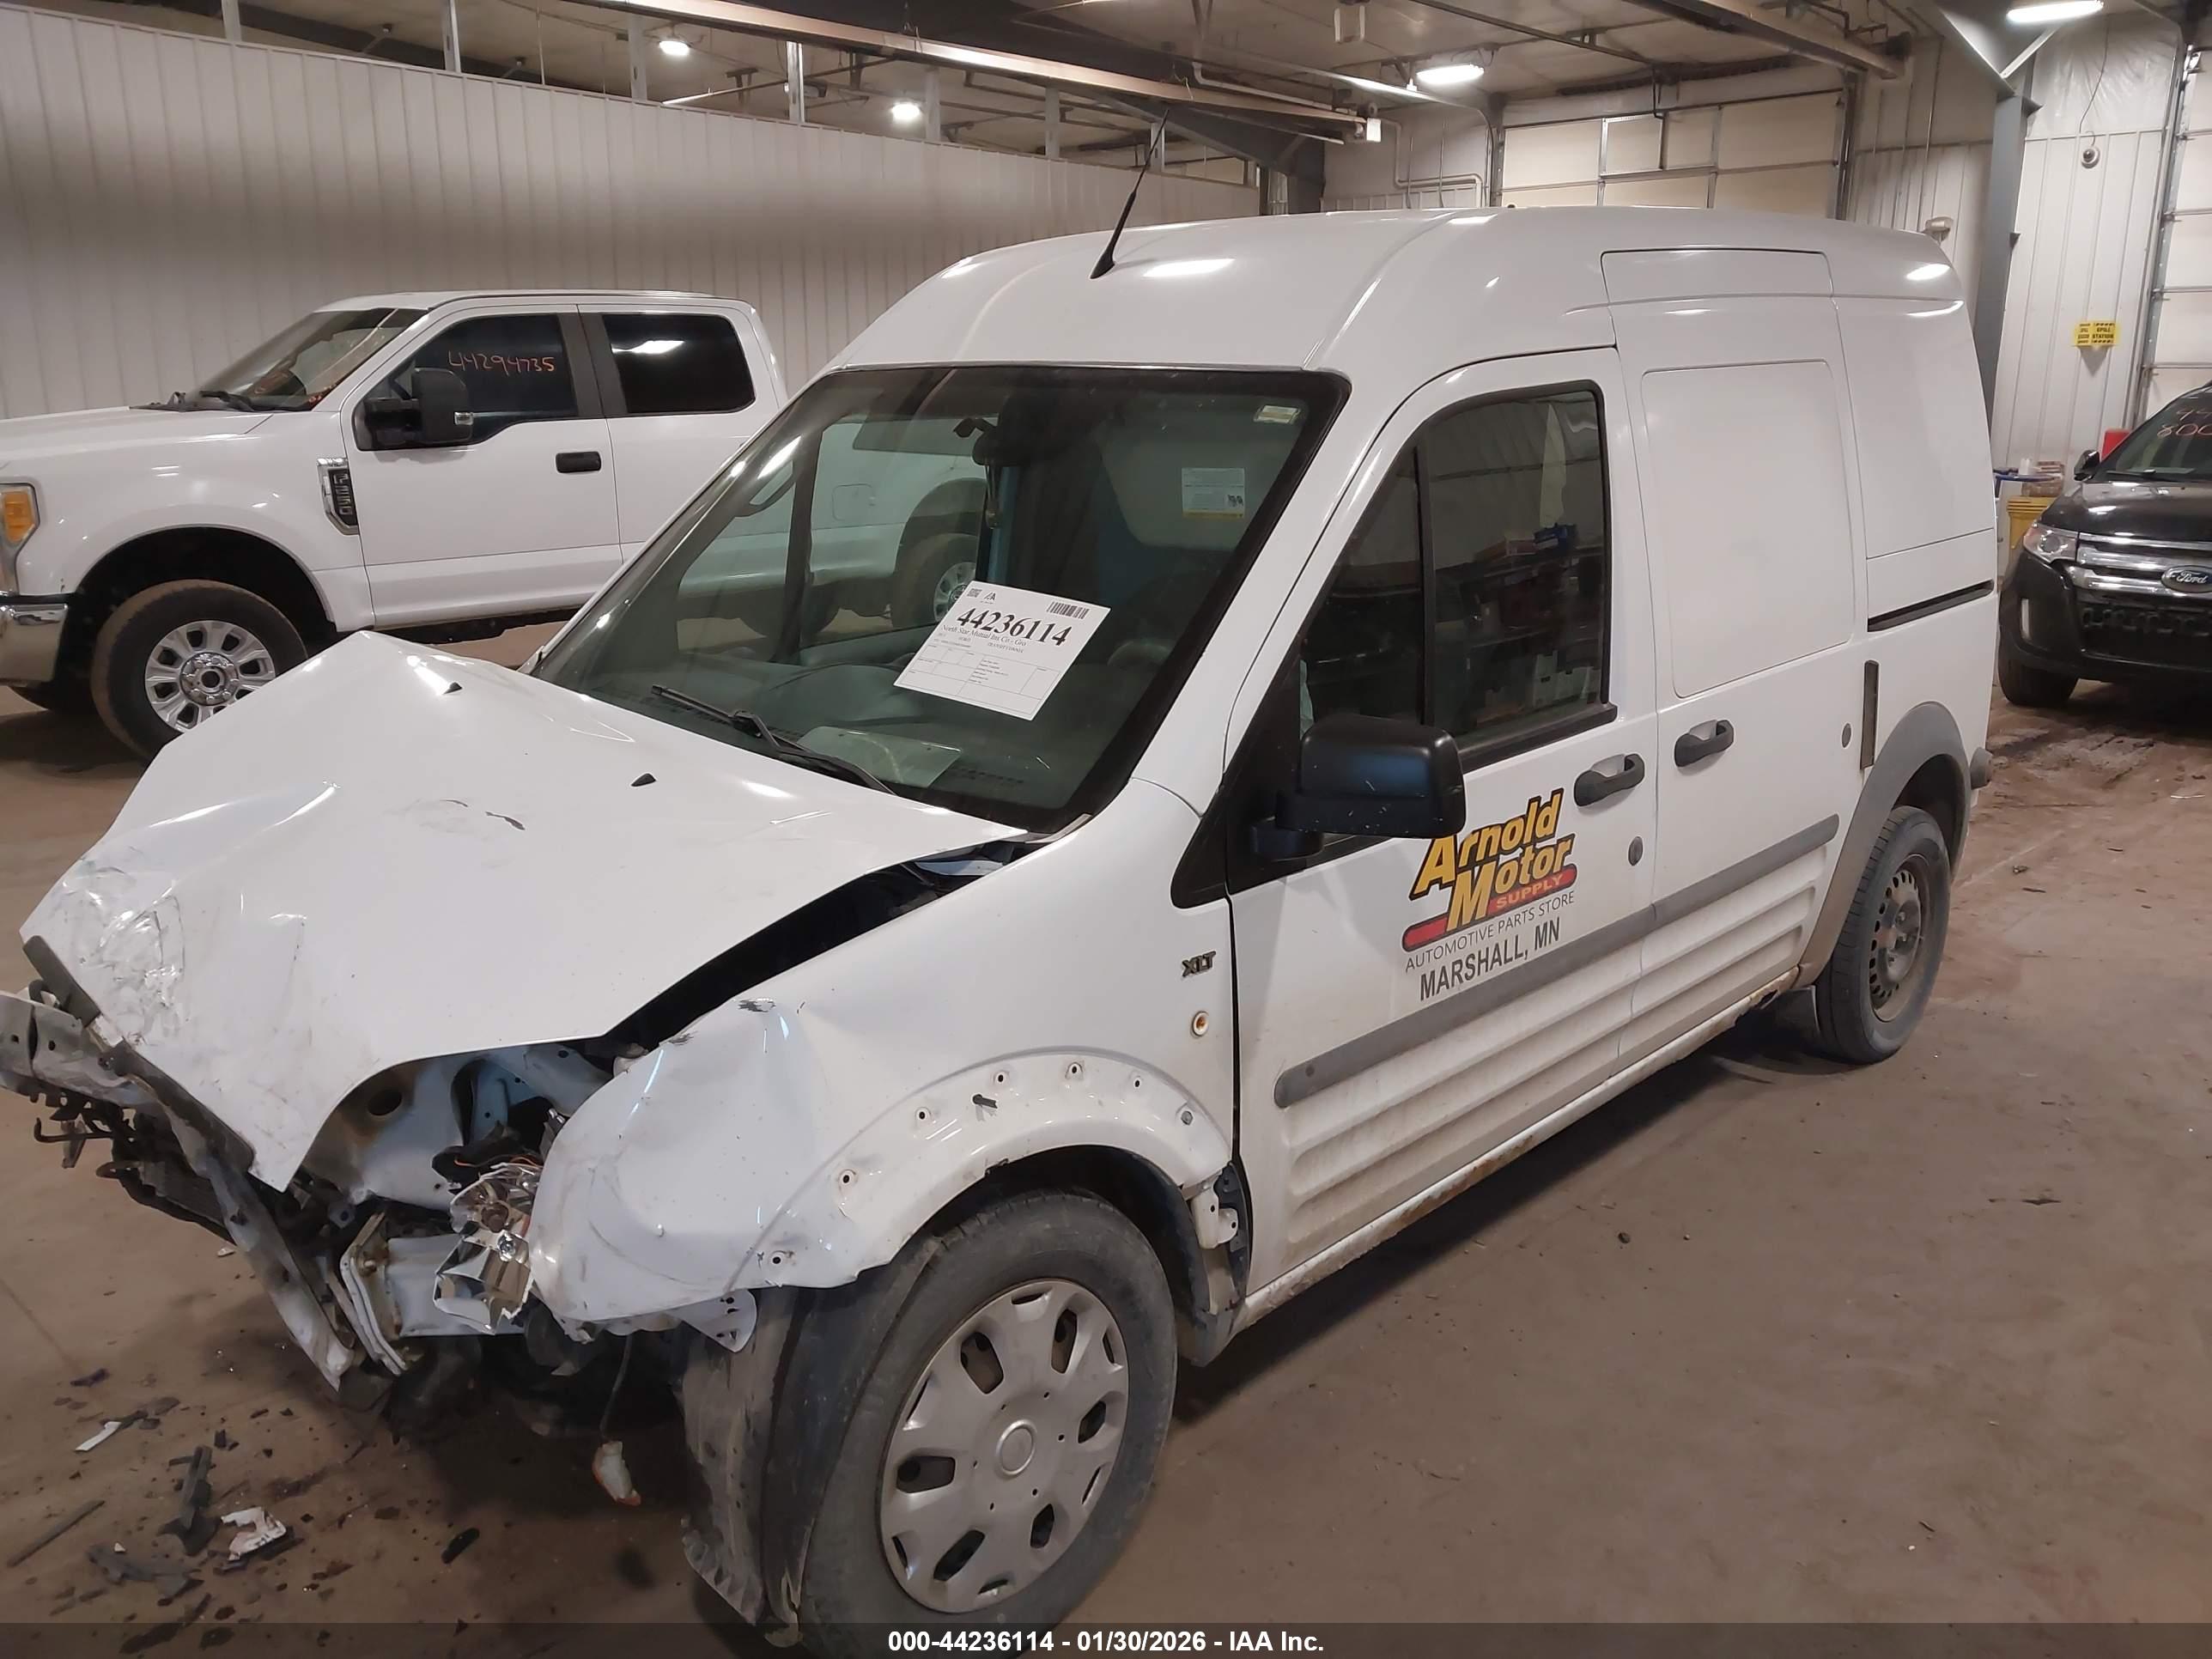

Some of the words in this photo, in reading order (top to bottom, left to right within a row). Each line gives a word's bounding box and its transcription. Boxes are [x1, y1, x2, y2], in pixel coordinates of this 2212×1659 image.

[448, 350, 556, 376] 44294735
[2176, 570, 2209, 584] Ford
[957, 607, 1073, 647] 44236114
[970, 629, 991, 640] Mutual
[1410, 788, 1565, 900] Arnold
[1445, 836, 1574, 933] Motor
[1496, 873, 1564, 910] SUPPLY
[1405, 925, 1494, 974] AUTOMOTIVE
[1498, 906, 1535, 936] PARTS
[1538, 890, 1575, 917] STORE
[1182, 950, 1217, 977] XLT
[1419, 933, 1529, 1002] MARSHALL,
[1534, 915, 1561, 951] MN
